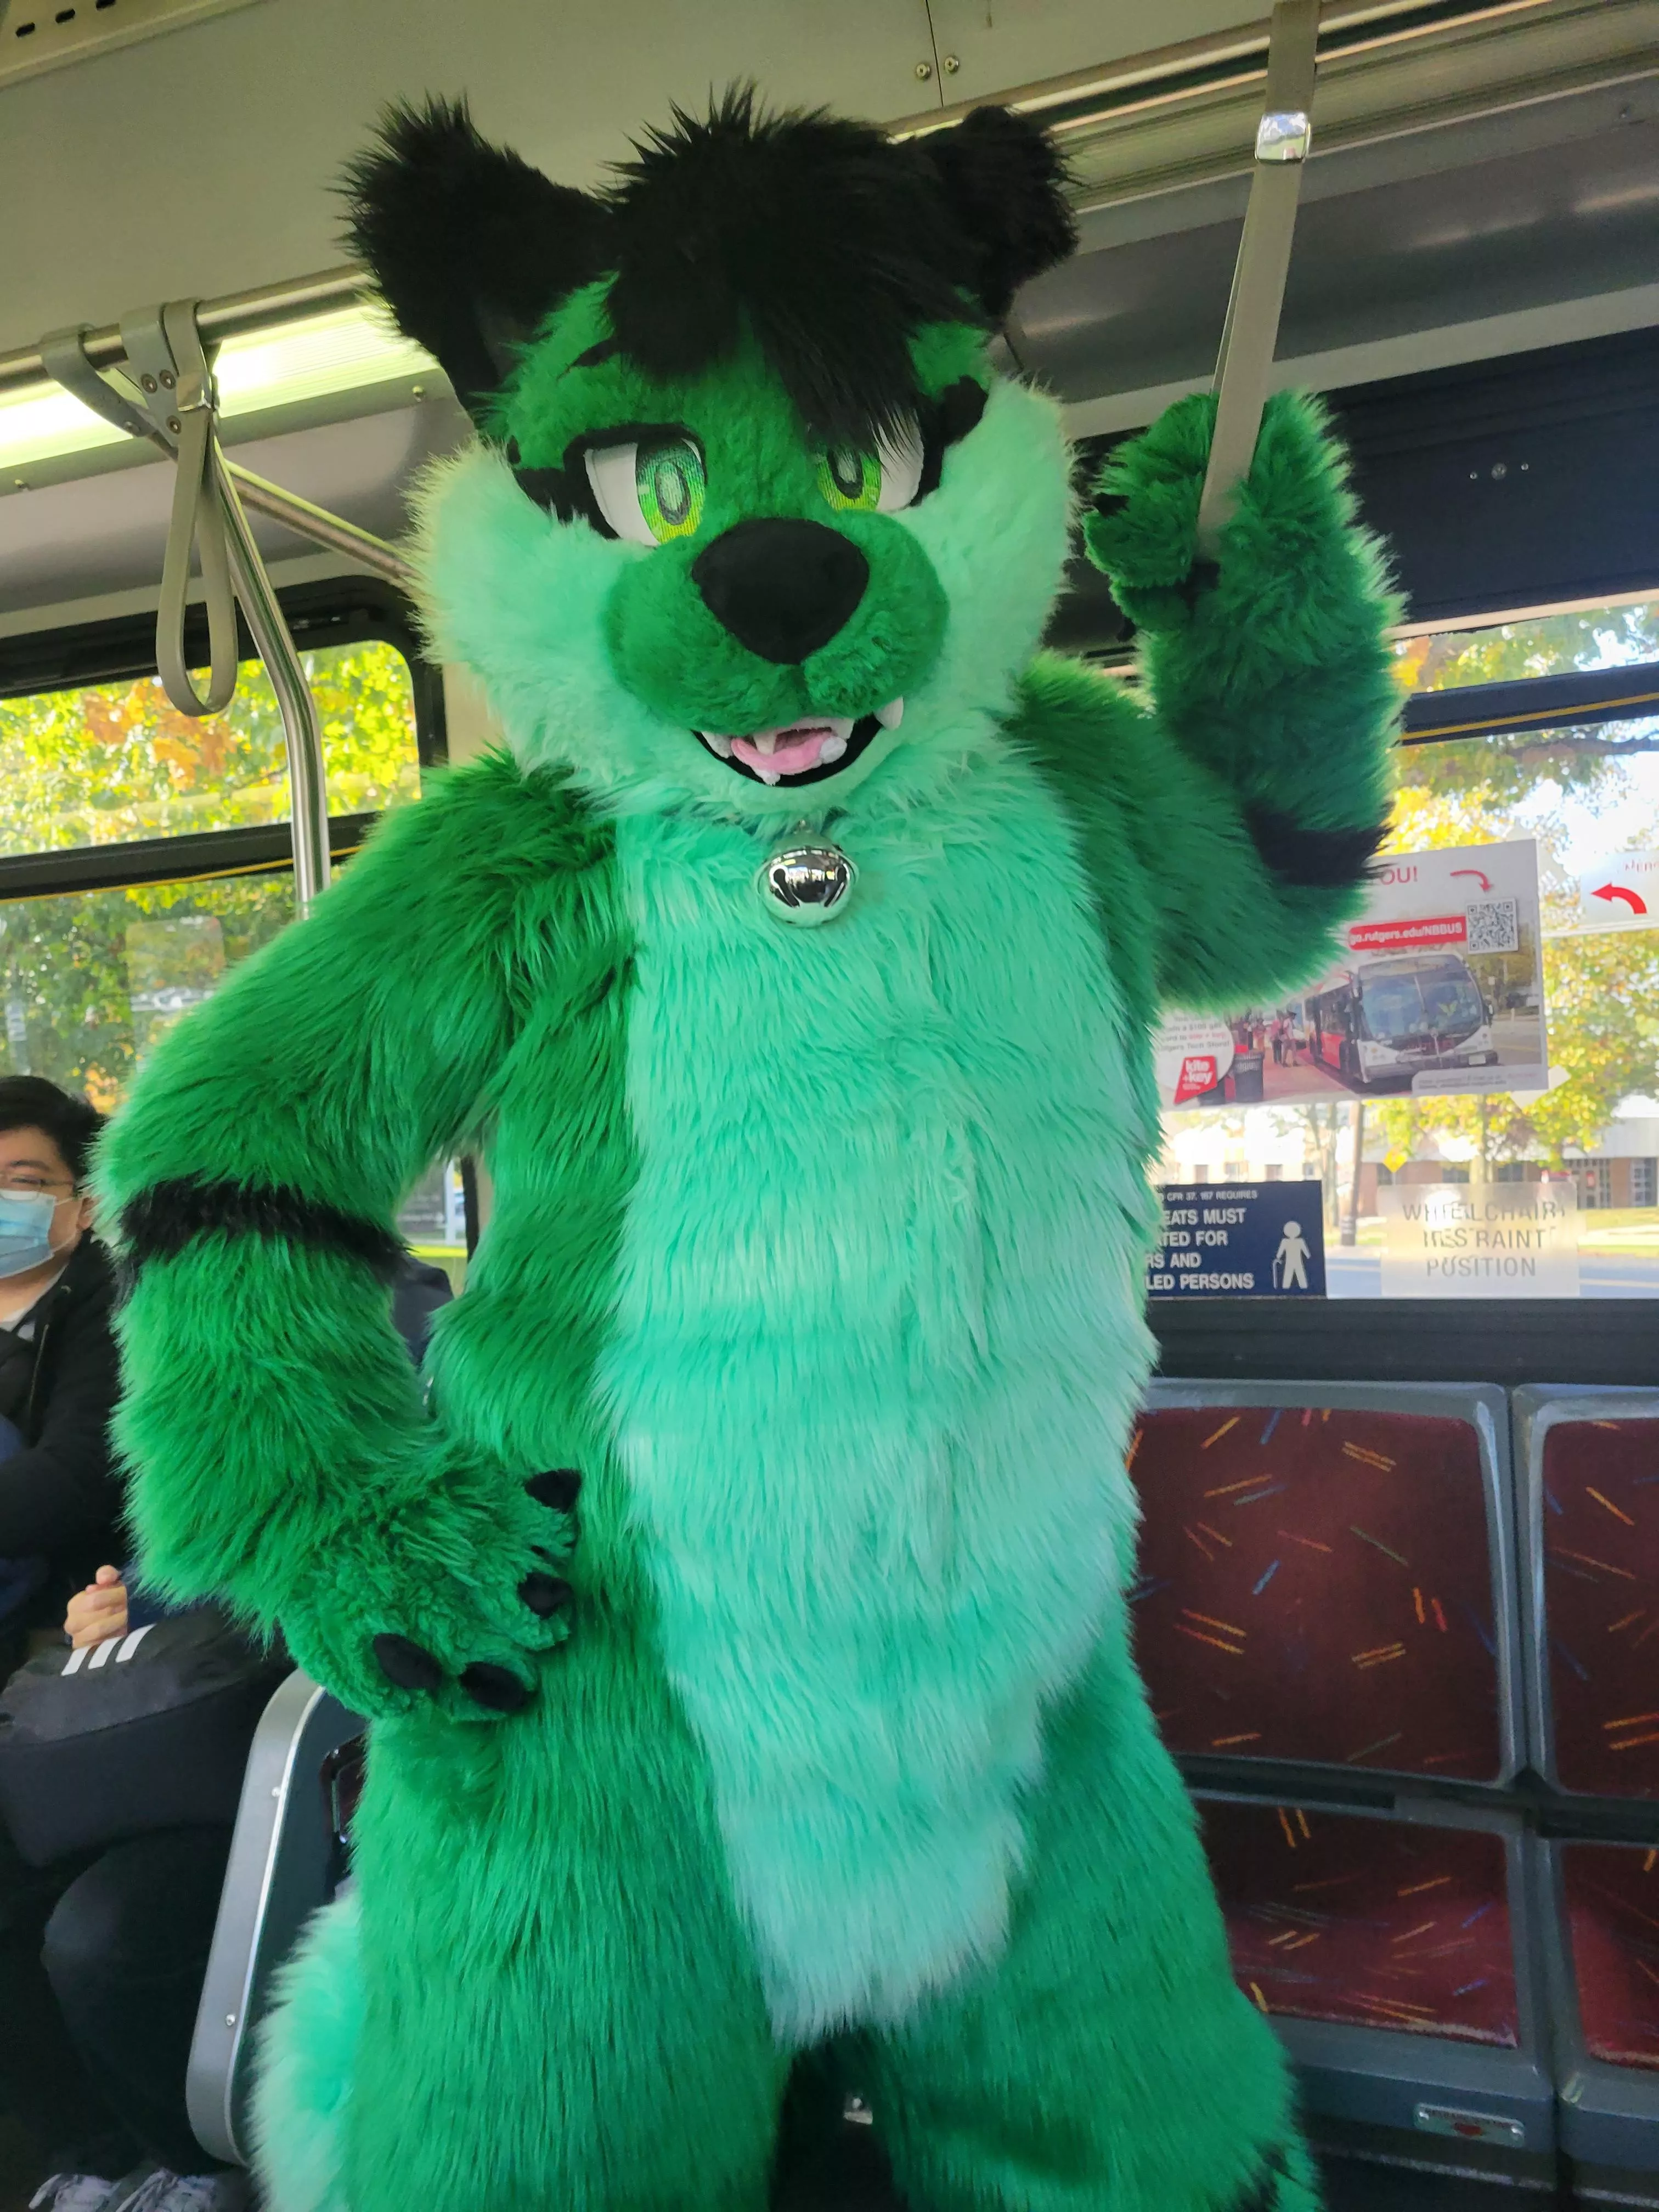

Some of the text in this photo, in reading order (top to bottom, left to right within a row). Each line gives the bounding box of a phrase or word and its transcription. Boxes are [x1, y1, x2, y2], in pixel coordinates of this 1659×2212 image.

[1379, 866, 1418, 885] OU!
[1216, 1189, 1257, 1200] REQUIRES
[1164, 1207, 1247, 1226] EATS MUST
[1195, 1230, 1228, 1246] FOR
[1170, 1252, 1202, 1268] AND
[1427, 1256, 1536, 1277] POSITION
[1146, 1273, 1255, 1290] LED PERSONS
